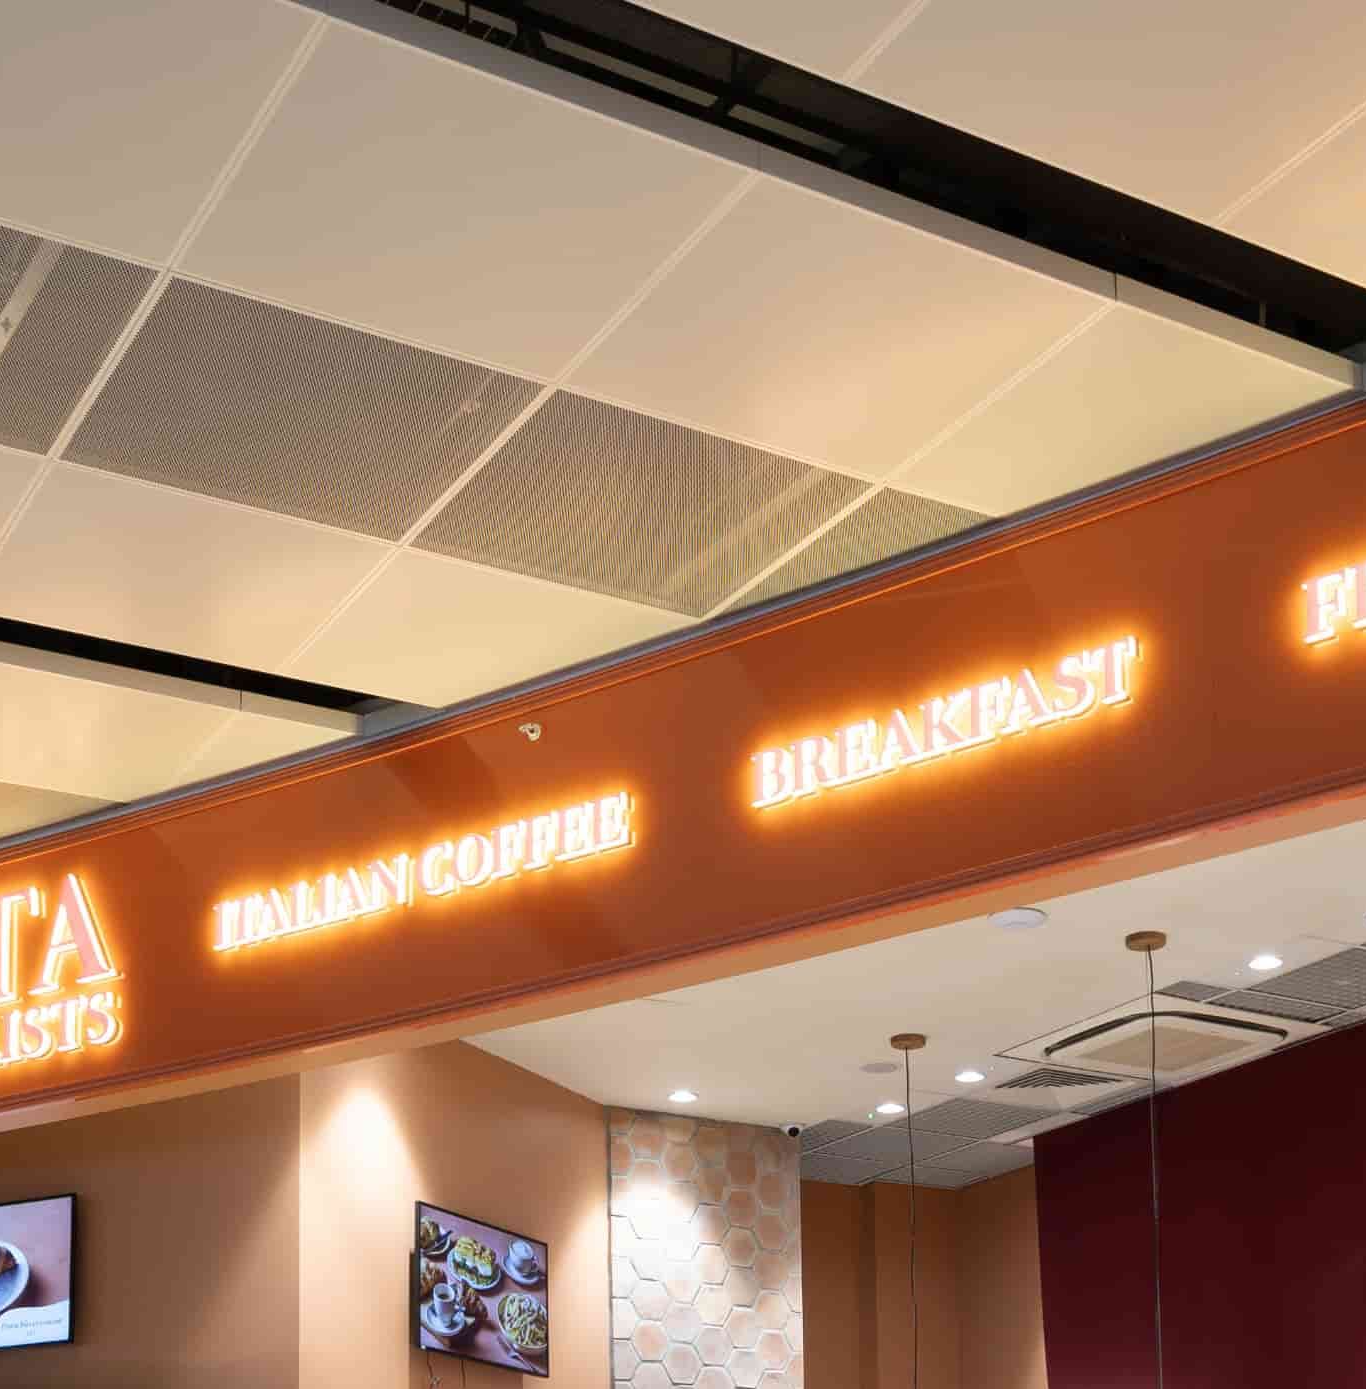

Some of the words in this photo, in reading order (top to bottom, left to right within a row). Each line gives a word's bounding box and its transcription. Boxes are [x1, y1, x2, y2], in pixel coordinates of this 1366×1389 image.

[750, 635, 1143, 808] BREAKFAST
[213, 852, 414, 951] ITALIAN
[419, 791, 635, 897] COFFEE
